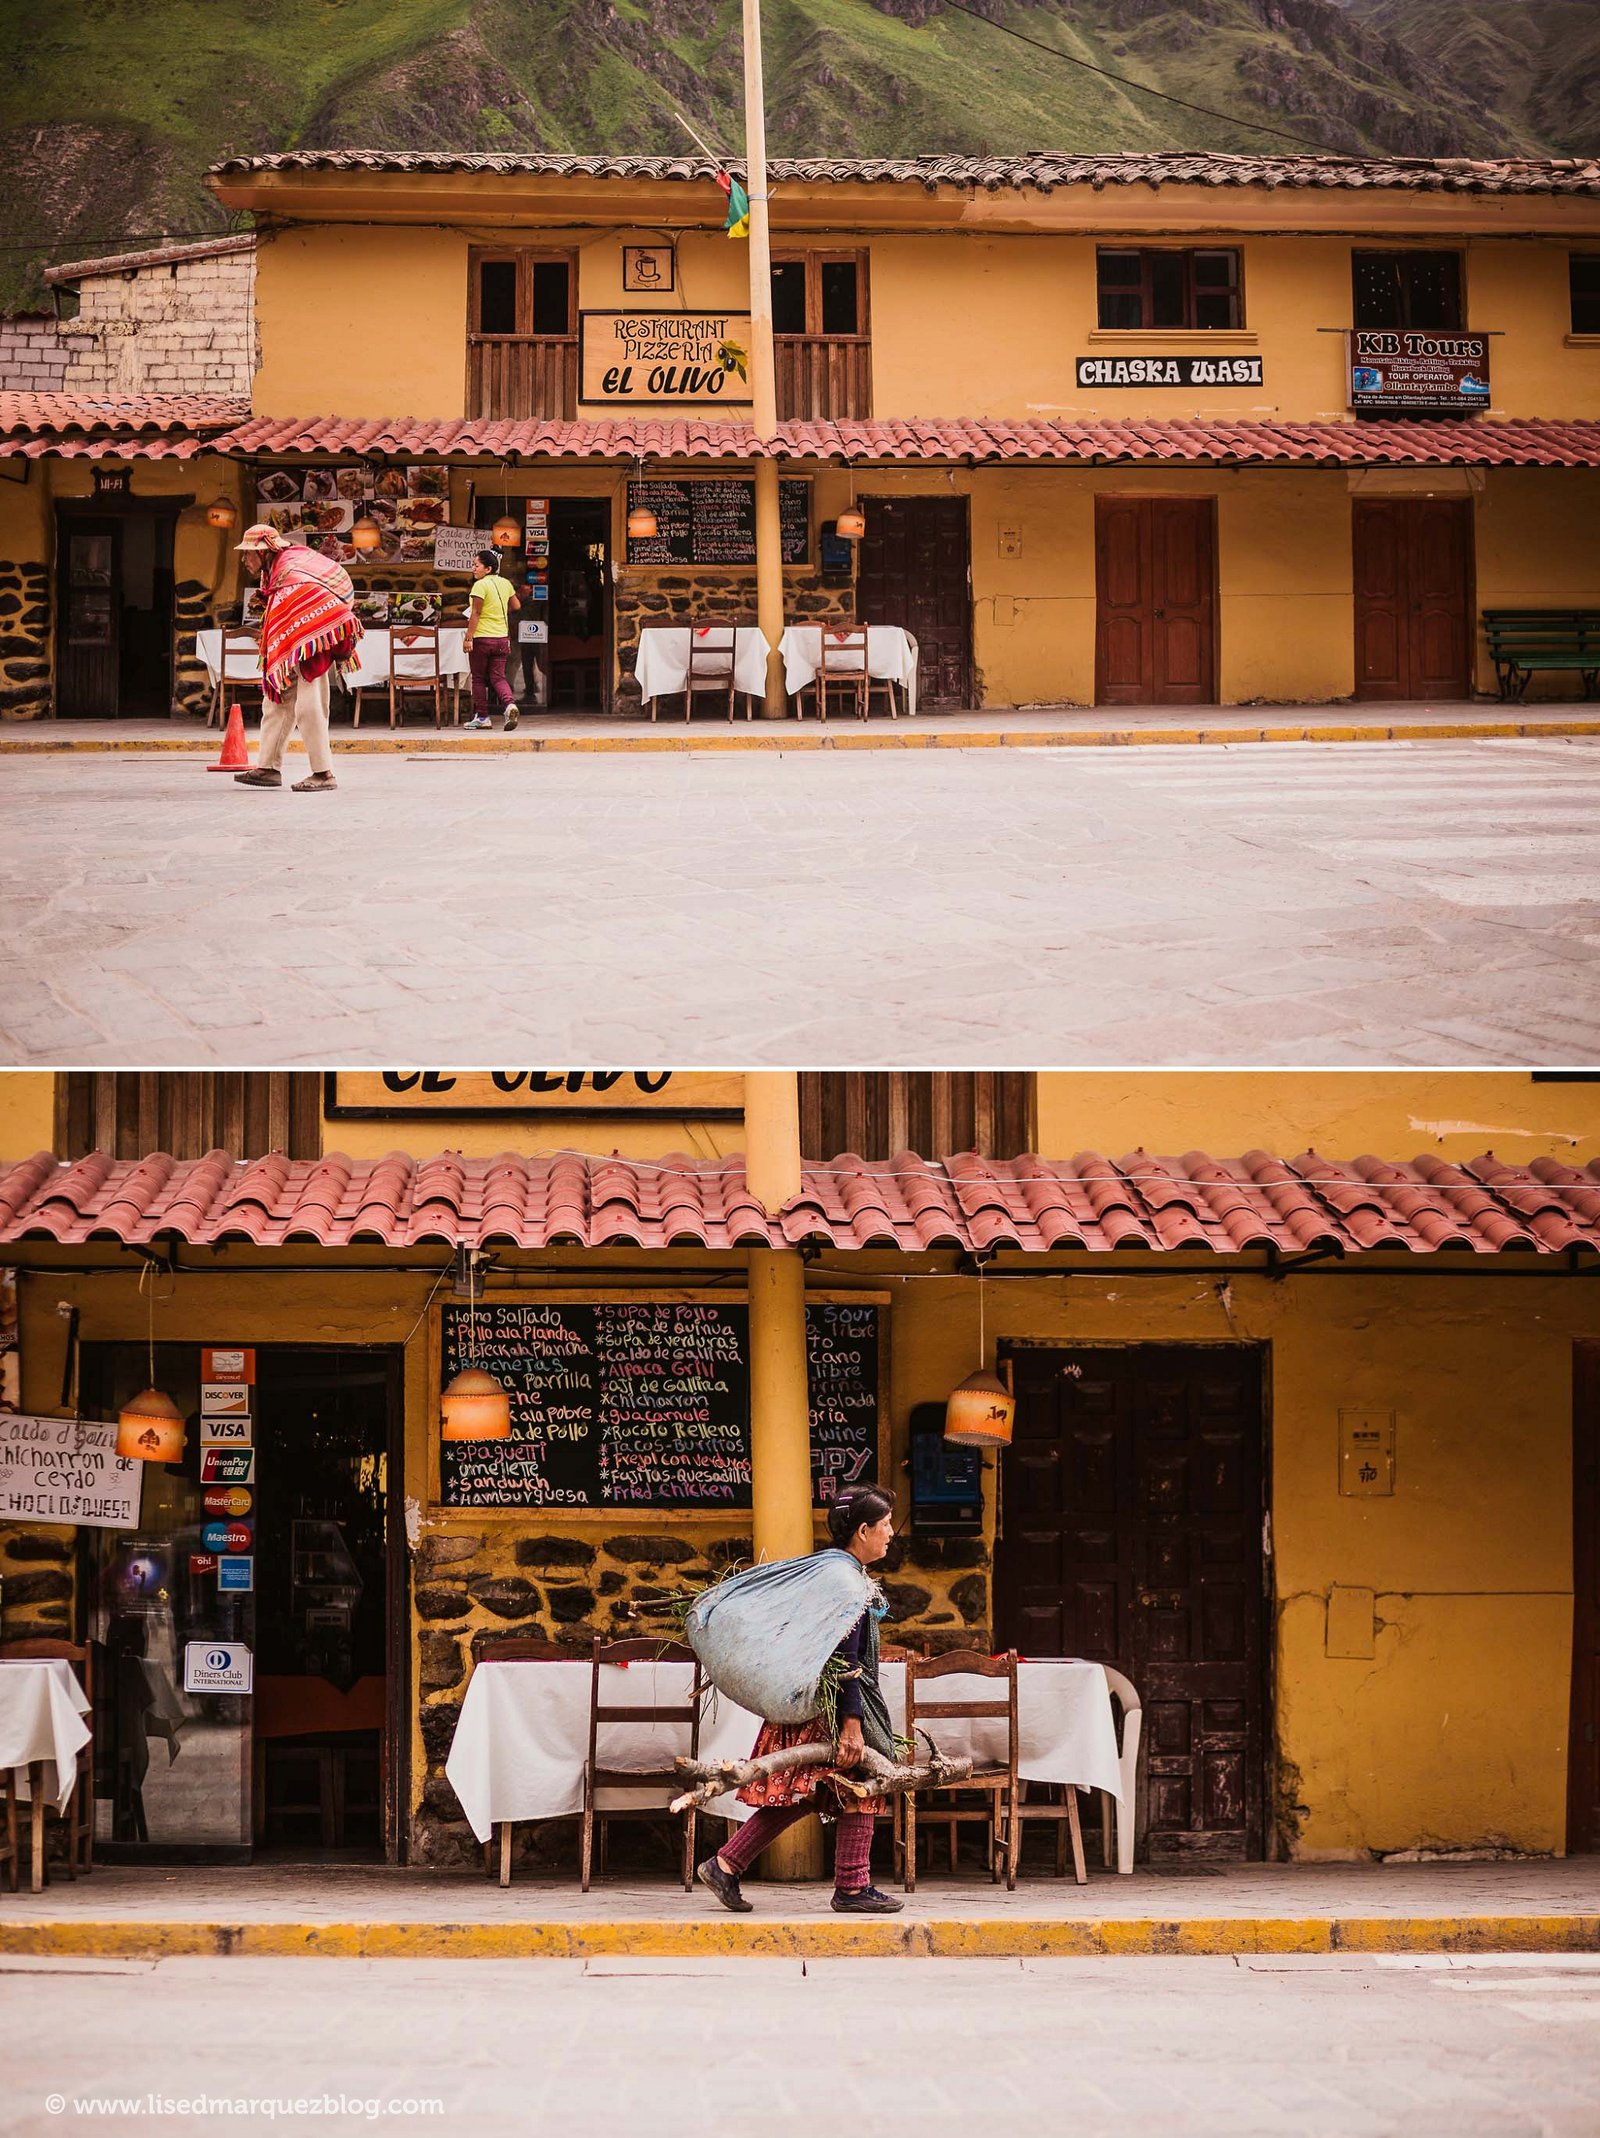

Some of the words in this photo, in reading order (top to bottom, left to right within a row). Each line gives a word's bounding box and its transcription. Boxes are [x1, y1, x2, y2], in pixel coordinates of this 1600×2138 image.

[613, 318, 728, 340] RESTAURANT
[623, 339, 713, 364] PIZZERIA
[1357, 333, 1400, 355] KB
[1404, 333, 1482, 357] Tours
[602, 366, 634, 394] EL
[647, 366, 725, 394] OLIVO
[1079, 360, 1181, 384] CHASKA
[1190, 360, 1261, 383] WASI
[1413, 373, 1454, 381] OPERATOR
[1384, 381, 1459, 393] Ollantaytambo
[207, 1424, 245, 1437] VISA
[0, 1445, 104, 1469] hicharron
[207, 1457, 249, 1470] UnionPay
[34, 1469, 95, 1489] cerdo
[204, 1497, 250, 1506] MasterCard
[207, 1533, 246, 1542] Maestro
[194, 1670, 221, 1679] Diners
[222, 1670, 242, 1679] Club
